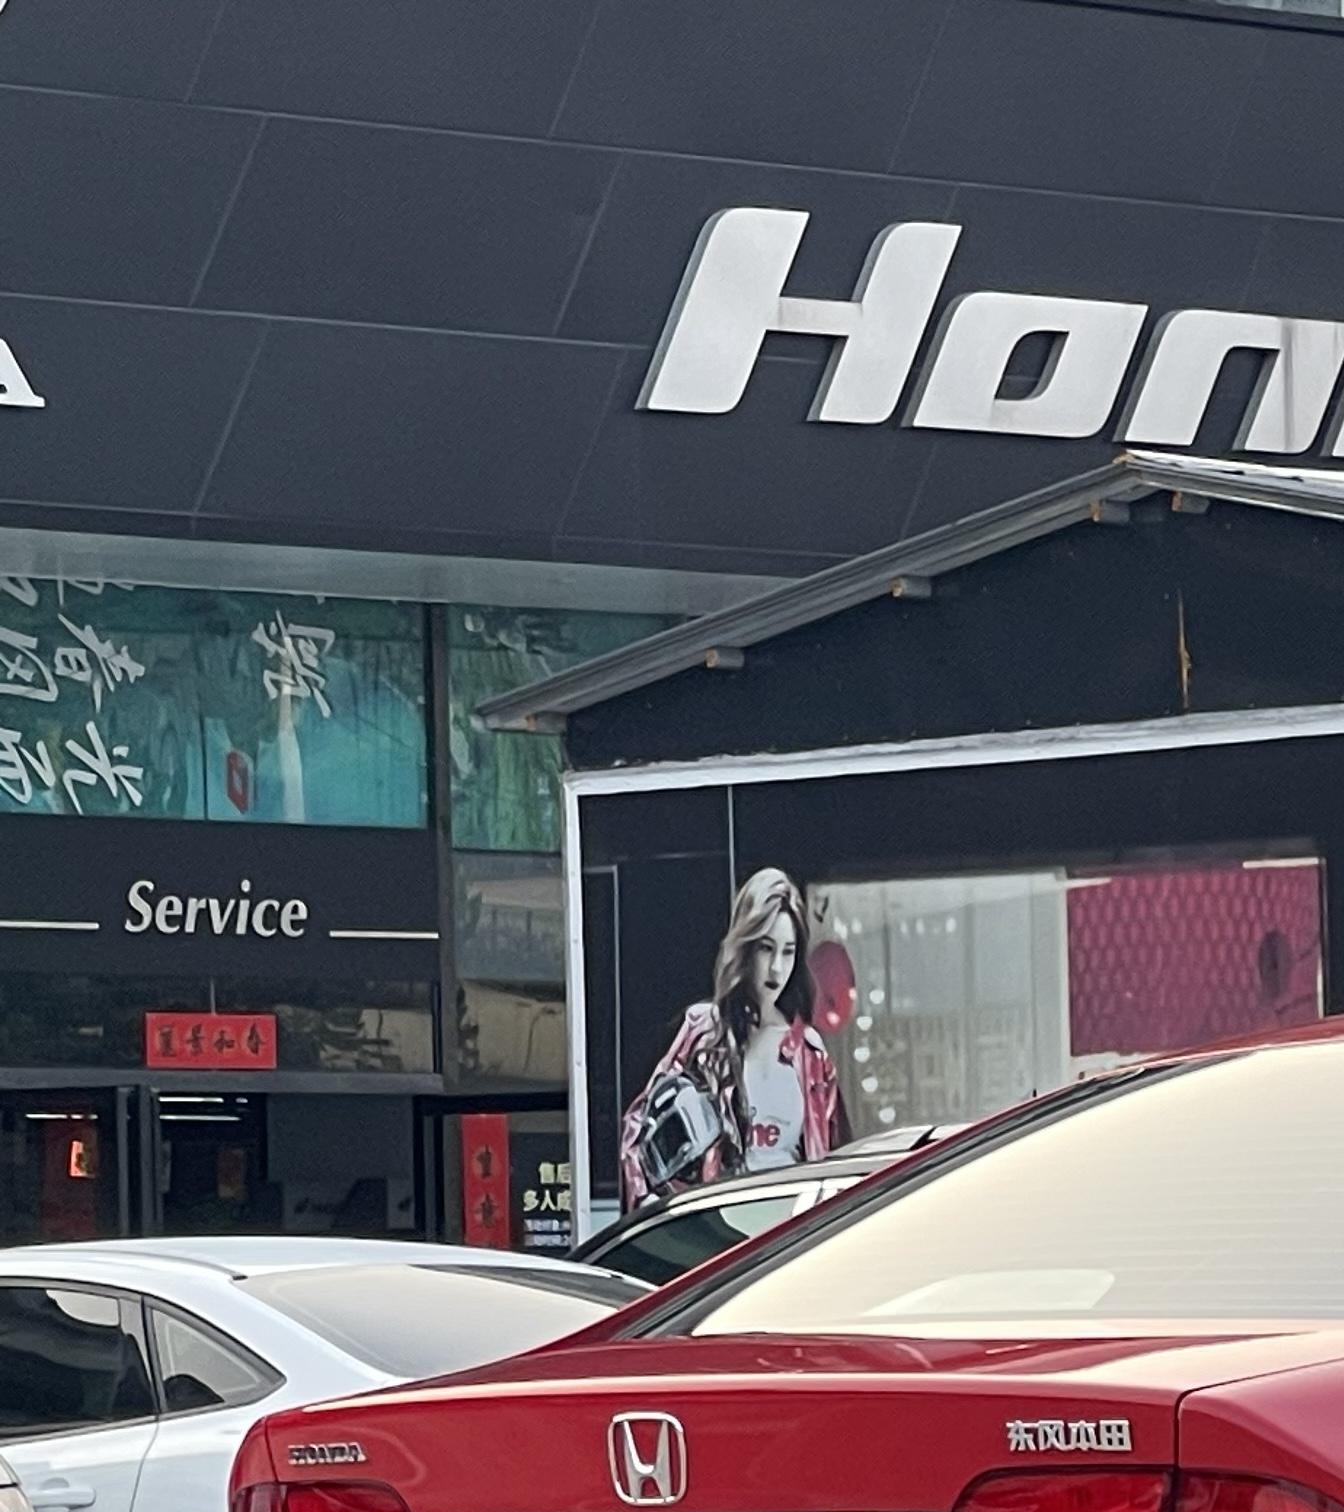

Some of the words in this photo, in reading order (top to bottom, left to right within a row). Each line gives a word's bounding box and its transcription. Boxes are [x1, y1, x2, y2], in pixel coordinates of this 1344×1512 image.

[124, 879, 308, 937] Service
[1006, 1420, 1133, 1451] 东风本田
[288, 1442, 366, 1465] HONDA
